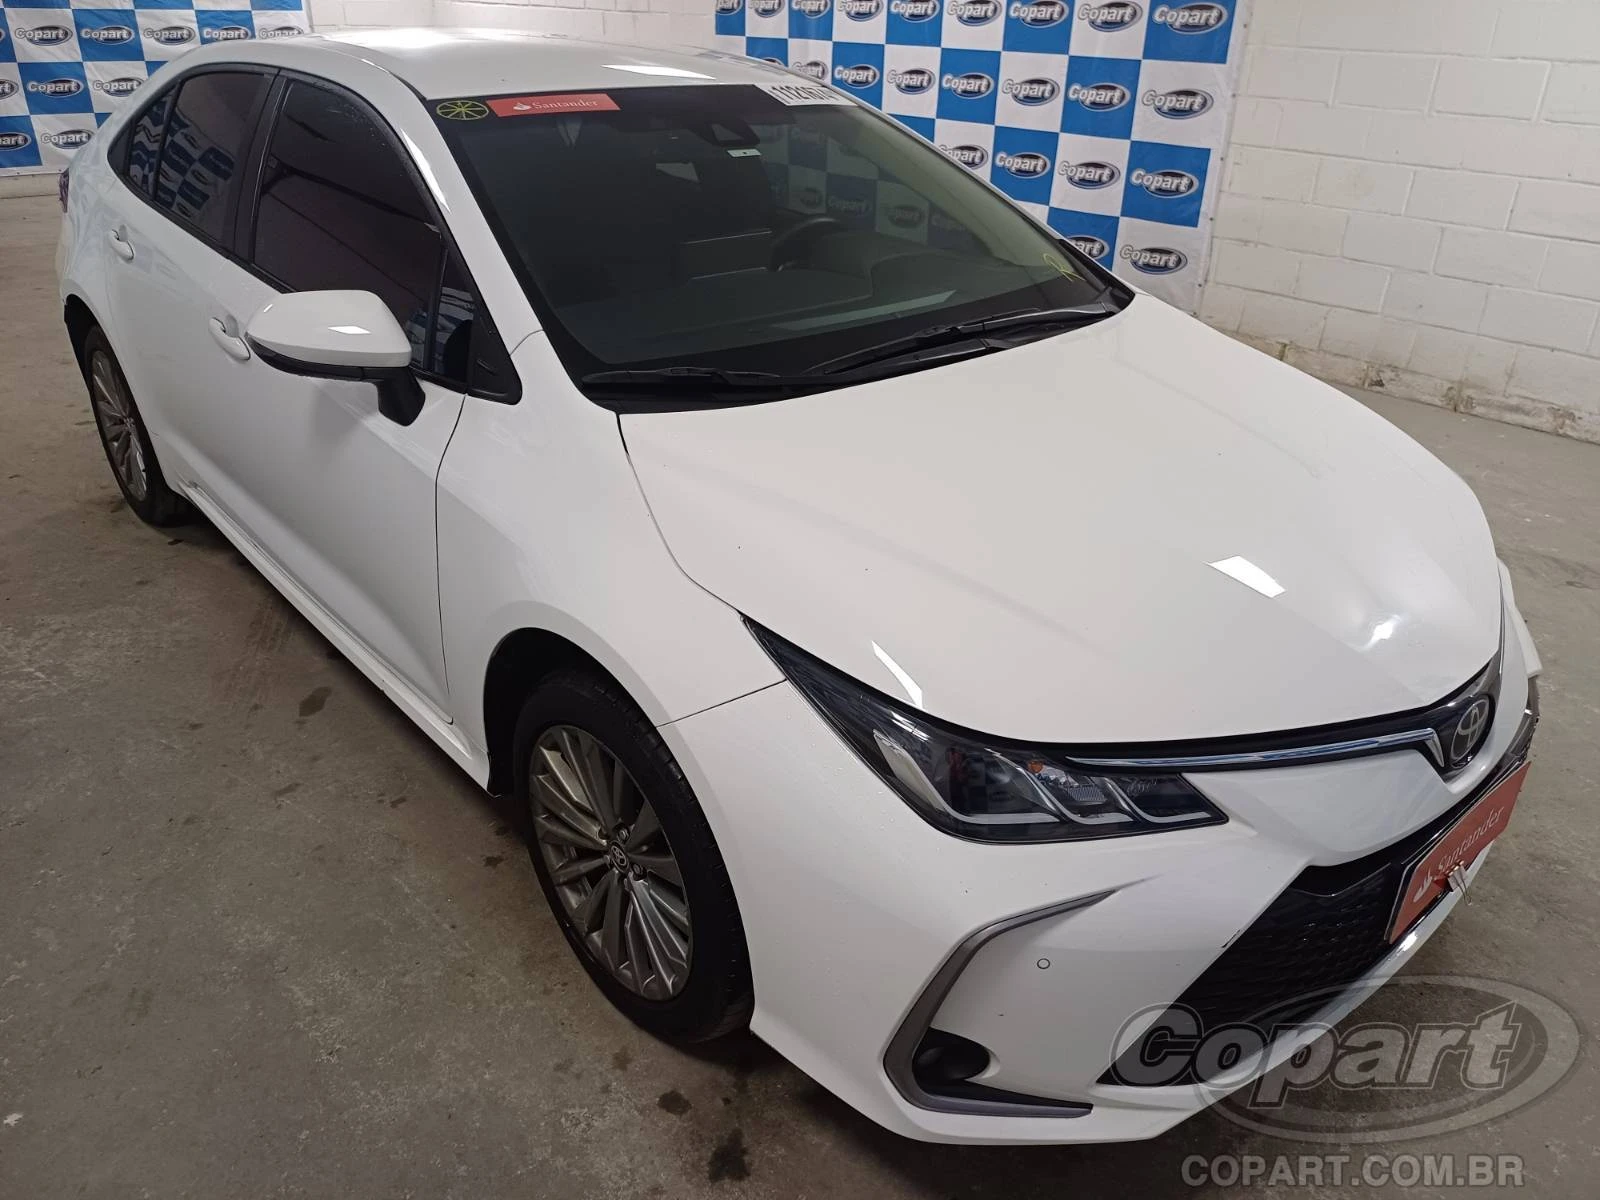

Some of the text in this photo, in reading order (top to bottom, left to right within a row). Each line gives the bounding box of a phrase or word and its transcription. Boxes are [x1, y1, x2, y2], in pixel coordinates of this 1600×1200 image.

[891, 2, 936, 18] Copart
[947, 1, 997, 19] Copart
[1009, 2, 1061, 23] Copart
[1078, 4, 1133, 27] Copart
[1154, 6, 1220, 30] Copart
[15, 28, 65, 41] Copart
[81, 28, 129, 41] Copart
[144, 28, 190, 41] Copart
[203, 27, 248, 40] Copart
[834, 65, 875, 84] Copart
[888, 70, 929, 89] Copart
[942, 73, 988, 94] Copart
[27, 80, 78, 95] Copart
[93, 79, 141, 92] Copart
[1003, 79, 1052, 101] Copart
[532, 98, 599, 109] Santander
[1068, 84, 1121, 107] Copart
[1142, 90, 1203, 114] Copart
[42, 132, 89, 147] Copart
[995, 151, 1043, 174] Copart
[1058, 160, 1110, 183] Copart
[1131, 169, 1189, 192] Copart
[1120, 244, 1177, 269] Copart
